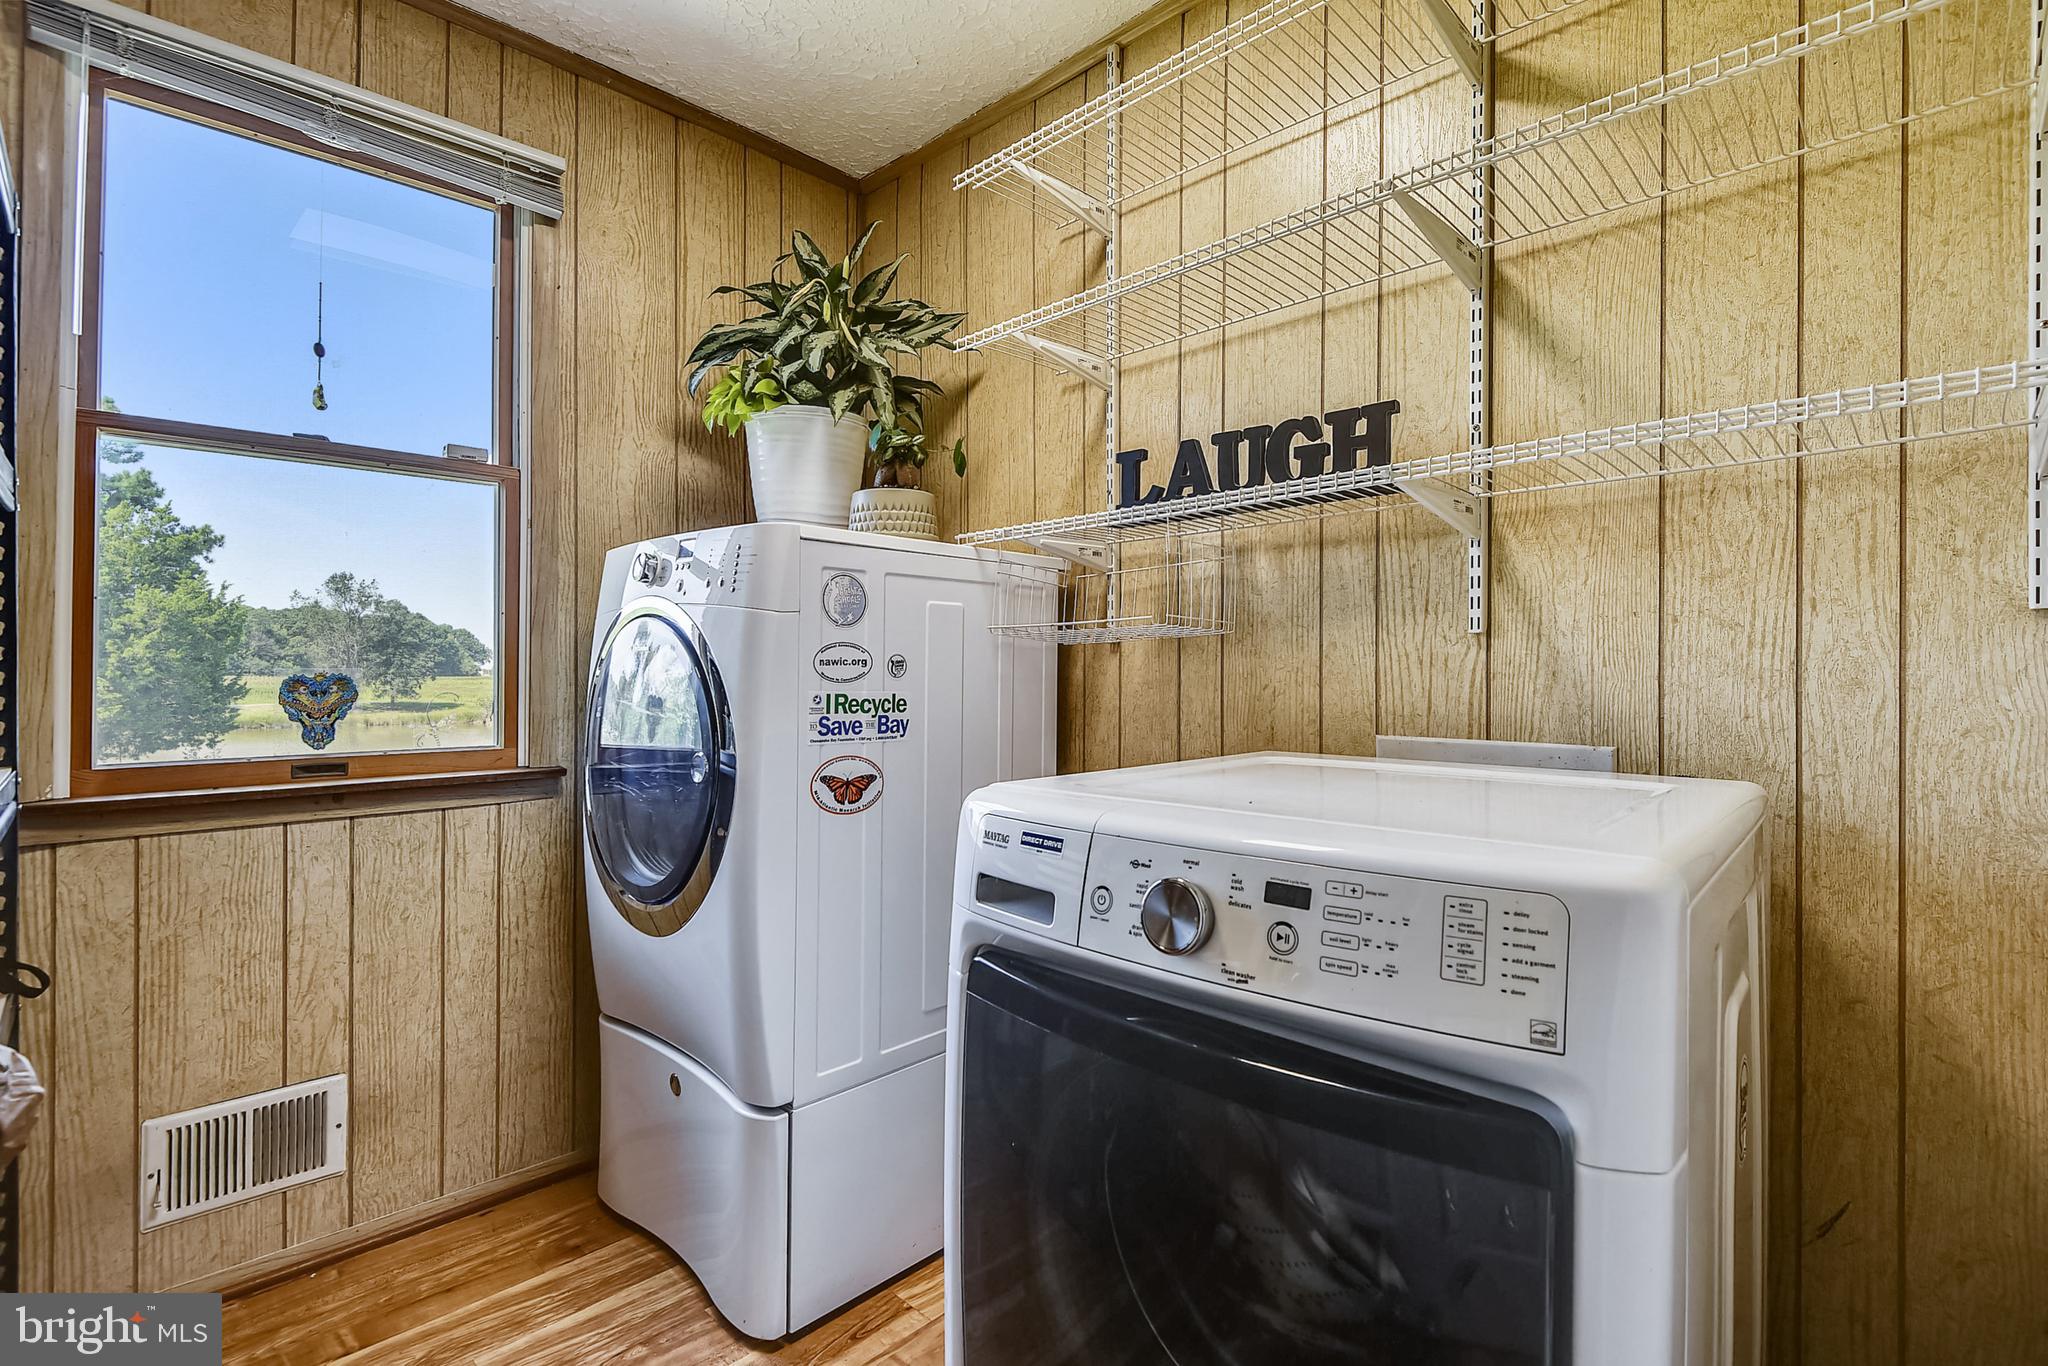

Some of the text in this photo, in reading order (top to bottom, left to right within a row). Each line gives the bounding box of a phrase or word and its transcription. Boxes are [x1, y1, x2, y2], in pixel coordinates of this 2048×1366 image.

[1116, 400, 1400, 509] LAUGH
[819, 656, 867, 668] nawic.org
[825, 693, 908, 718] I Recycle
[817, 715, 863, 737] Save
[877, 714, 910, 738] Bay
[983, 829, 1010, 844] MAYTAG
[1022, 835, 1063, 849] DIRECT DRIVE
[1182, 858, 1200, 866] normal
[1230, 885, 1244, 893] wash
[1228, 900, 1252, 910] delicates
[1327, 910, 1358, 920] temperature
[1513, 911, 1530, 919] delay
[1512, 926, 1549, 936] door locked
[1511, 943, 1536, 951] sensing
[1325, 962, 1352, 972] spin speed
[1511, 958, 1523, 966] add
[1529, 961, 1556, 970] garment
[1221, 967, 1236, 977] clean
[1236, 971, 1256, 981] washer
[1511, 973, 1539, 984] steaming
[1510, 988, 1526, 997] done
